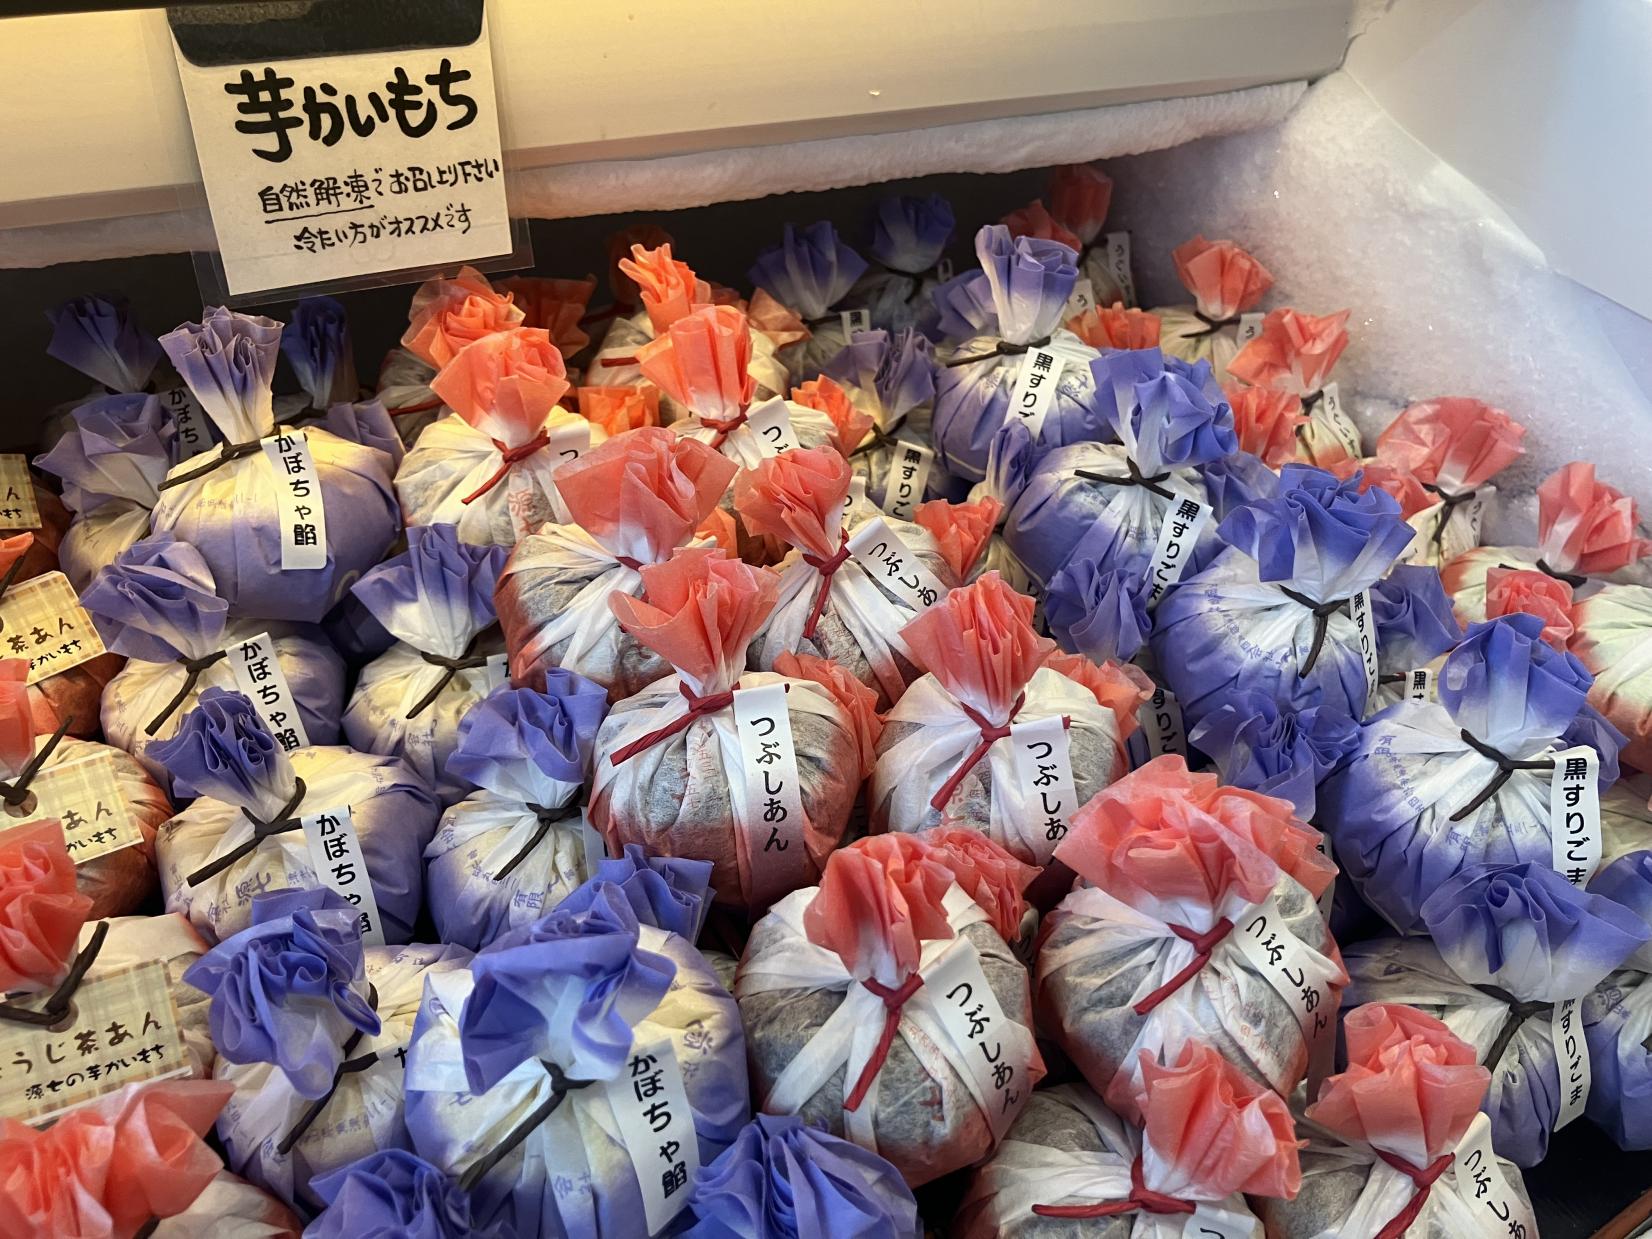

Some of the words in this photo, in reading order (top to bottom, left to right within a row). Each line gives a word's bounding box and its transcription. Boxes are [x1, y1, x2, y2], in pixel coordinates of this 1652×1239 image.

[224, 58, 478, 162] 芋かいもち
[293, 203, 472, 254] 冷たい方がオススメです
[274, 434, 317, 546] かぼちゃ餡
[62, 801, 113, 830] あん
[750, 717, 788, 852] つぶしあん
[1027, 741, 1068, 841] つぶしあ
[1246, 916, 1328, 1038] つぶしあん
[0, 1011, 162, 1080] うじ茶あん
[946, 982, 1020, 1113] つぶしあん
[628, 1054, 688, 1199] かぼちゃ餡
